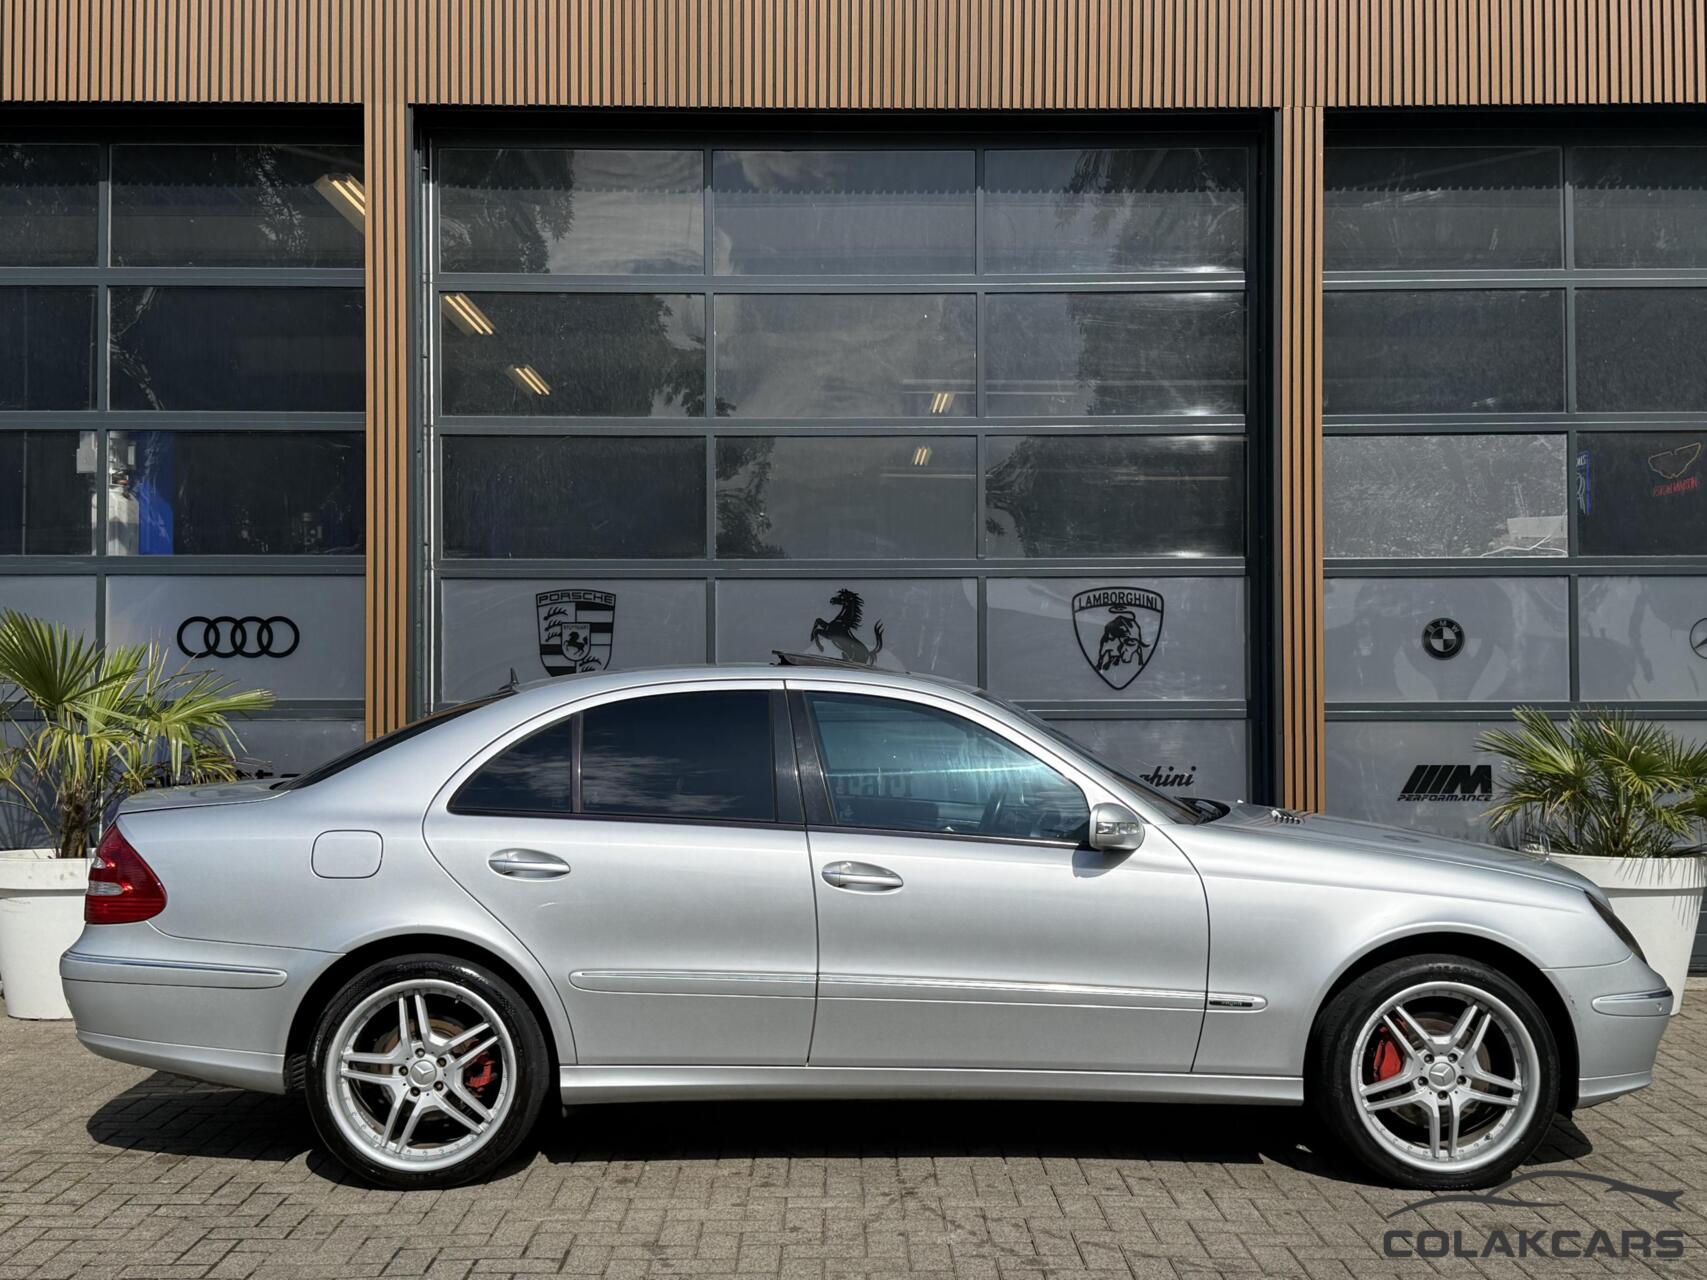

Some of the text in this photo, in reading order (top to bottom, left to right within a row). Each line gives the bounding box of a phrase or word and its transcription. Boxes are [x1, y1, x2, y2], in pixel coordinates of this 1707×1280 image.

[538, 591, 613, 605] PORSCHE
[1078, 591, 1158, 610] LAMBORGHINI
[1397, 794, 1494, 802] PERFORMANCE
